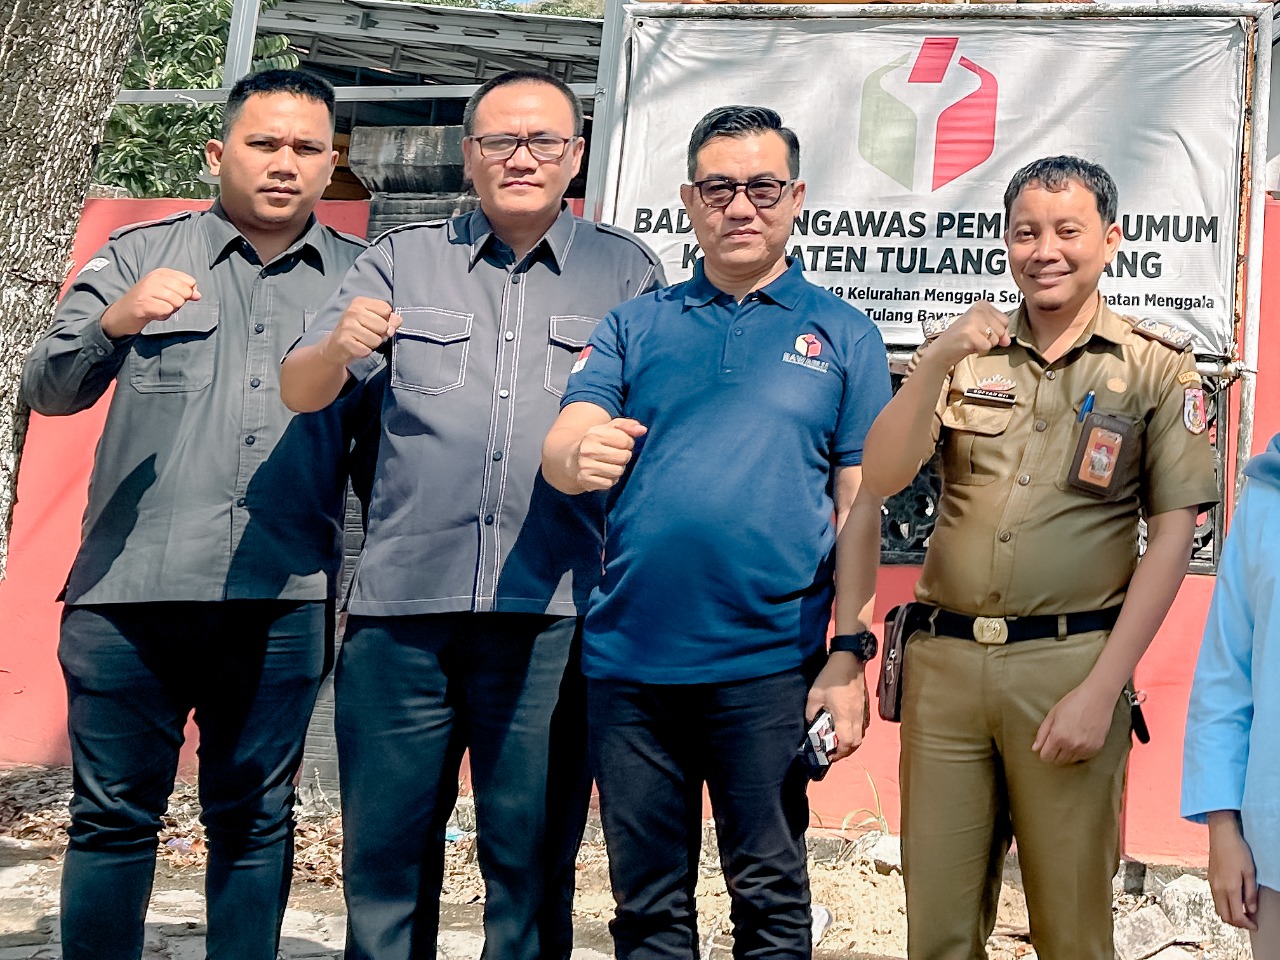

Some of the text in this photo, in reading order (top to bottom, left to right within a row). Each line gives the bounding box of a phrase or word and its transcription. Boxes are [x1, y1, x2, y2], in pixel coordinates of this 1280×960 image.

[633, 208, 694, 234] BAD
[790, 209, 927, 238] NGAWAS
[1122, 214, 1219, 243] UMUM
[877, 246, 1007, 276] TULANG
[847, 286, 920, 301] Kelurahan
[924, 288, 995, 305] Menggala
[1144, 293, 1216, 310] Menggala
[864, 307, 913, 324] Tulang
